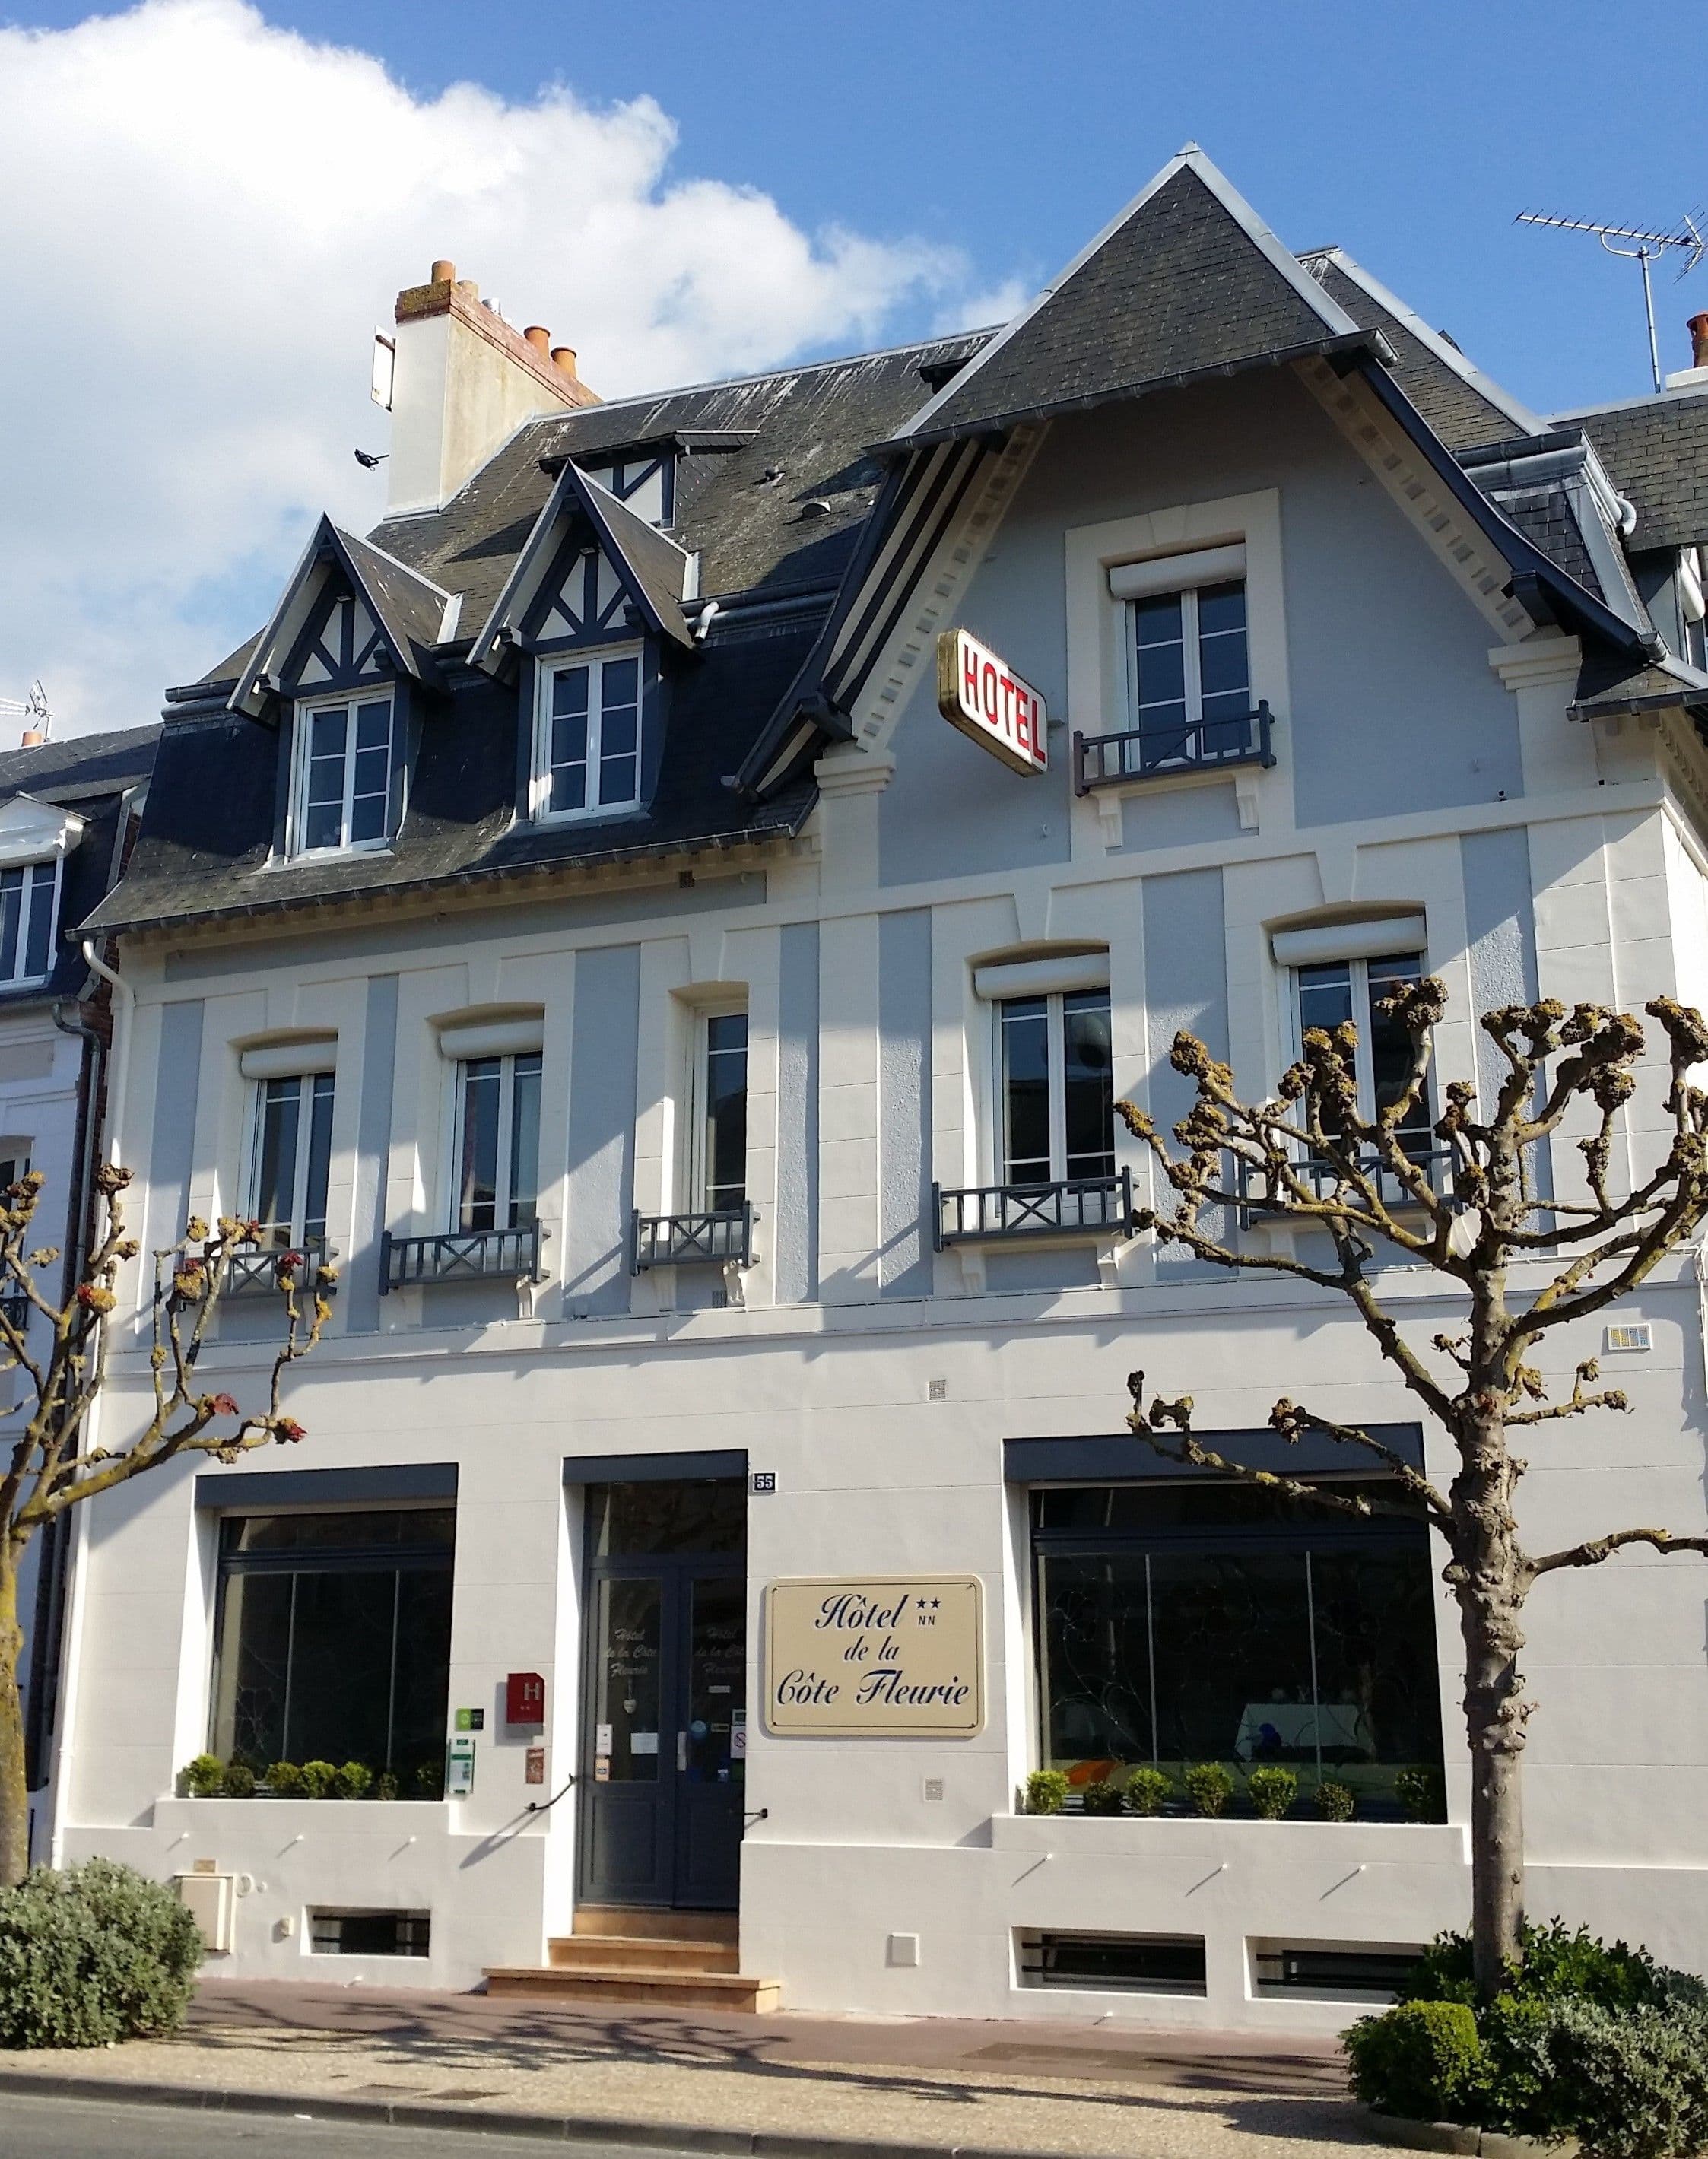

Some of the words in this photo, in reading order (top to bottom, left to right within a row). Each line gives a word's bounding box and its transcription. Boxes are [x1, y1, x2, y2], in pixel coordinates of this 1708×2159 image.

[964, 643, 1046, 764] HOTEL
[757, 1475, 773, 1489] 55
[814, 1593, 910, 1629] Hôtel
[918, 1615, 936, 1626] NN
[843, 1635, 869, 1662] de
[878, 1635, 900, 1662] la
[523, 1682, 540, 1701] H
[776, 1669, 840, 1705] Côte
[856, 1669, 970, 1705] Fleurie
